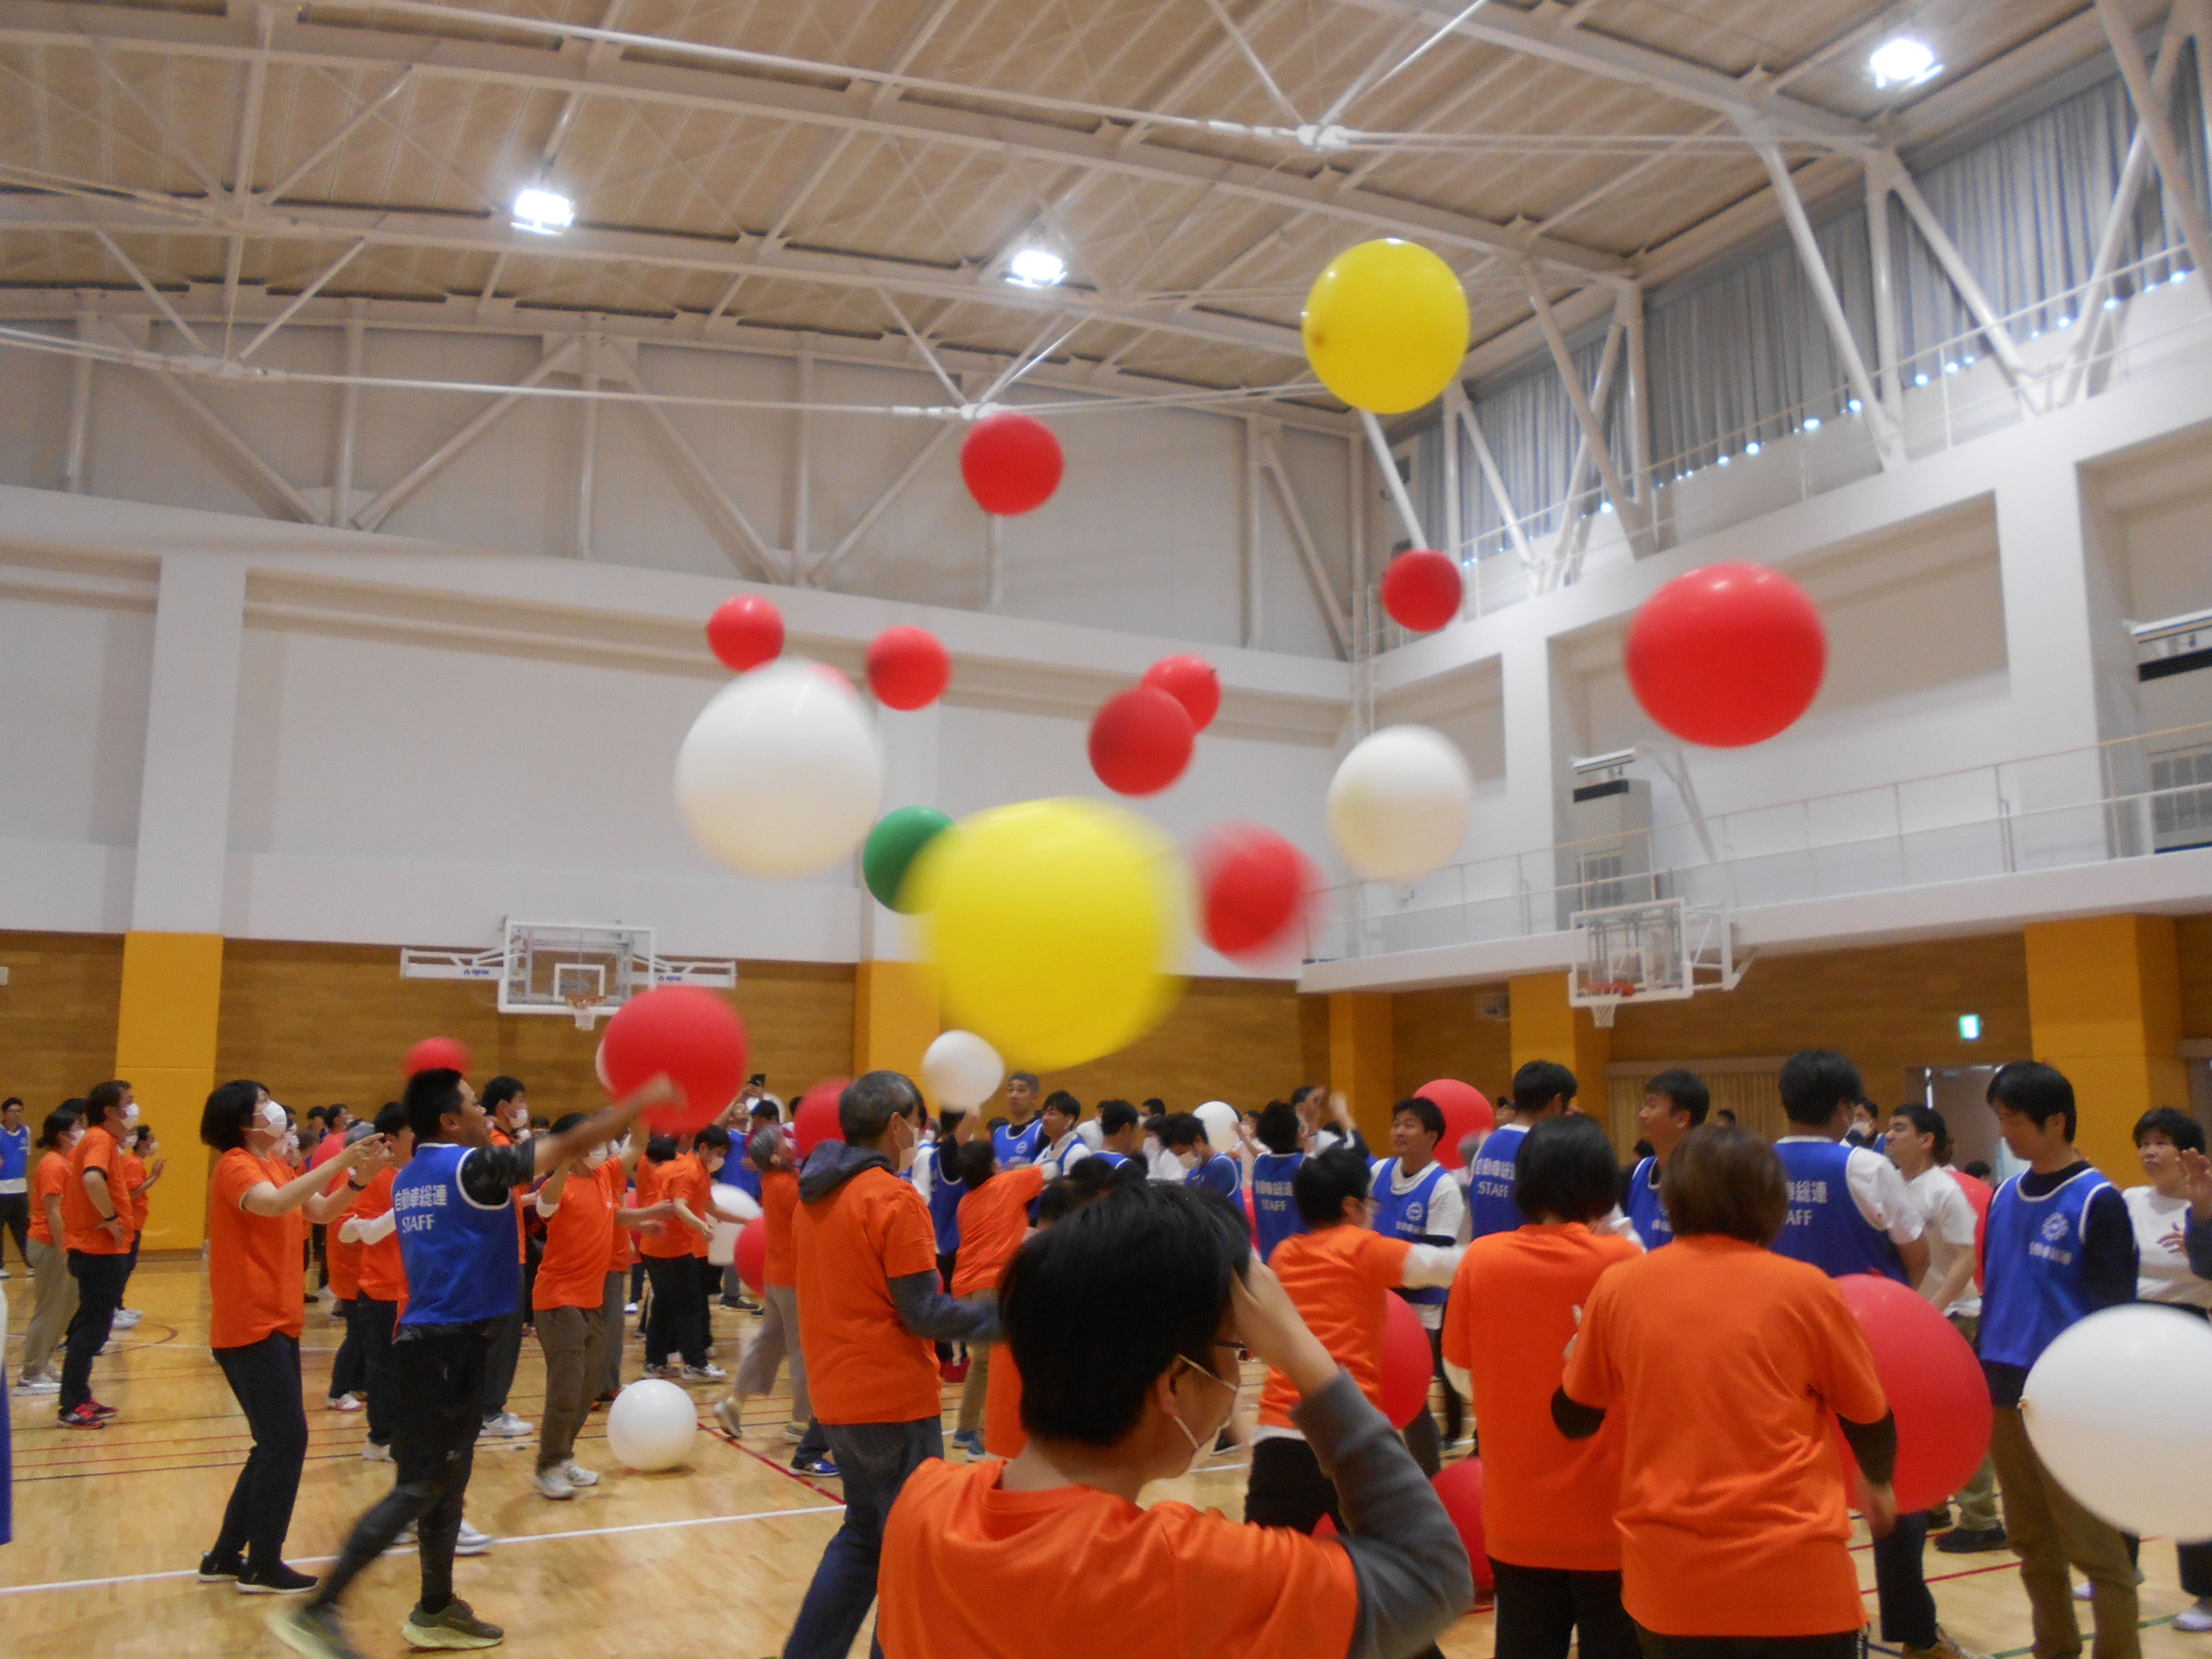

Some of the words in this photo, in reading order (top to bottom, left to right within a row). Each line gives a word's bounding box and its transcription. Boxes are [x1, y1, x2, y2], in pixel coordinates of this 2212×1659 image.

[395, 1184, 447, 1212] 自動車総連
[1478, 1181, 1509, 1198] STAFF
[402, 1214, 435, 1233] STAFF
[1786, 1209, 1812, 1225] AFF
